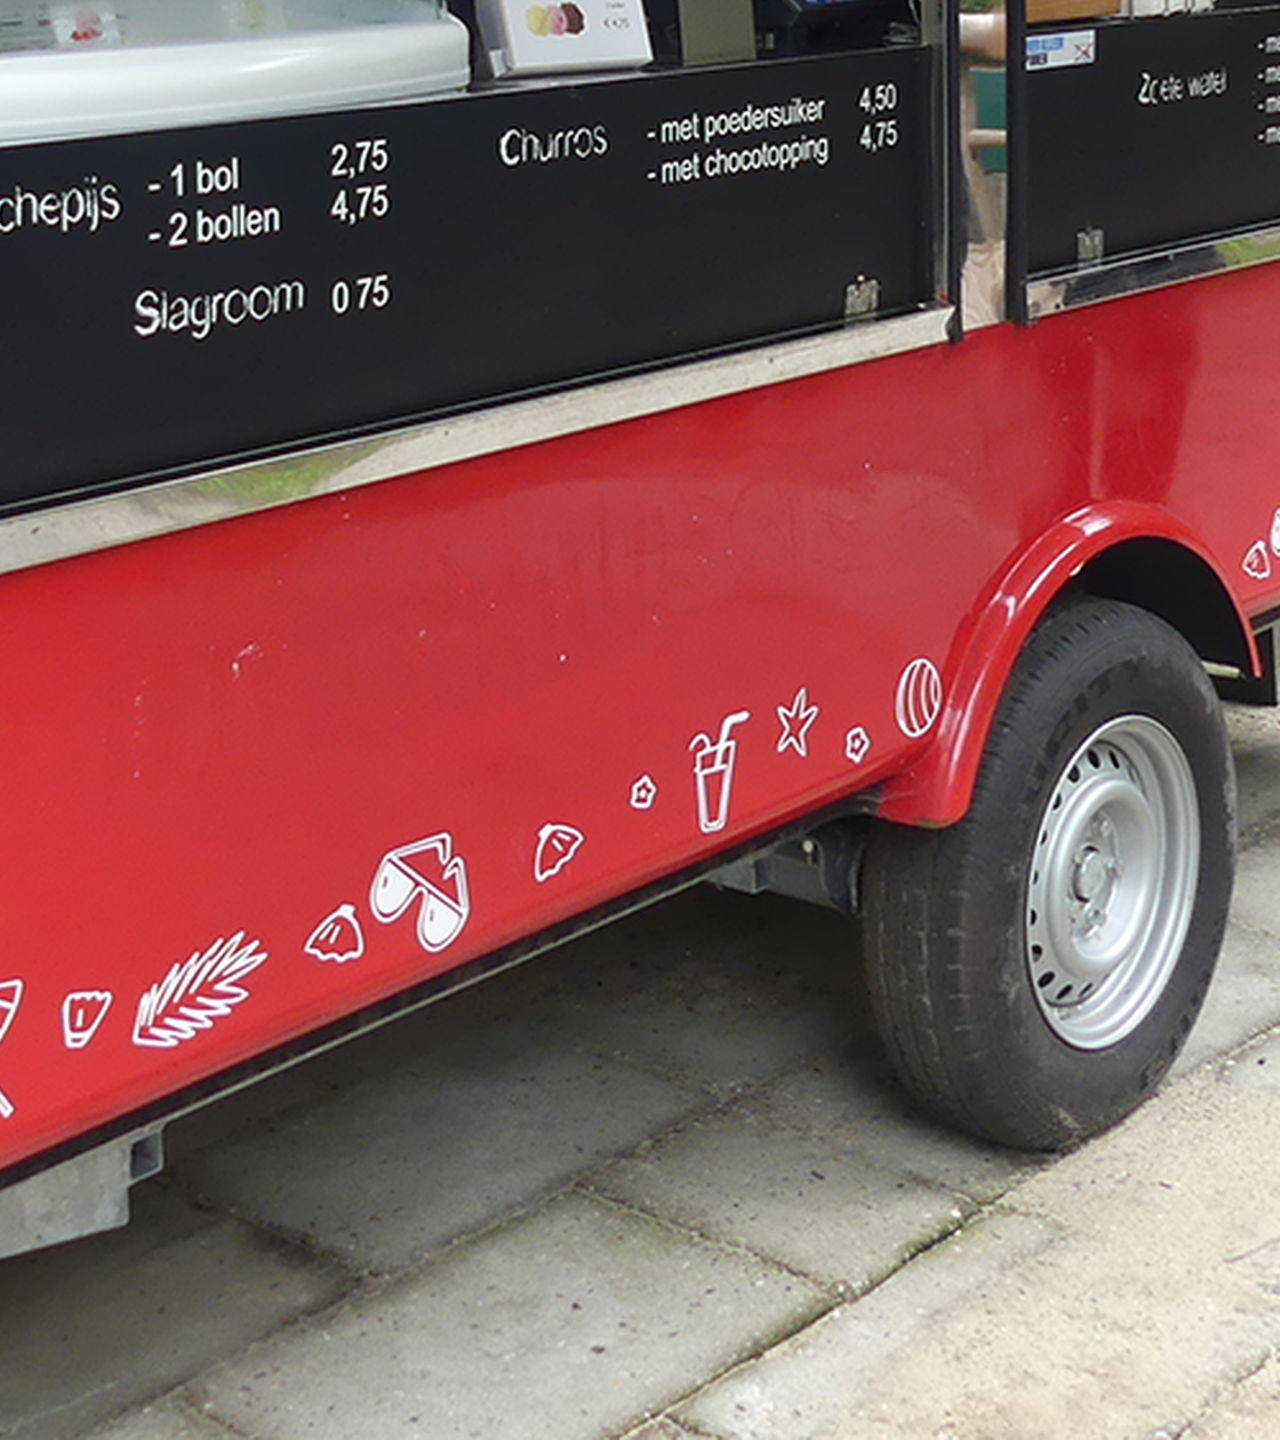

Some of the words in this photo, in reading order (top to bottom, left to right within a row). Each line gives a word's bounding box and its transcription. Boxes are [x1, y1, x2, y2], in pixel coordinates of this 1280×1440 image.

[661, 113, 700, 144] met
[705, 97, 826, 144] poedersuiker
[859, 83, 897, 116] 4,50
[196, 157, 239, 195] bol
[331, 139, 389, 179] 2,75
[500, 125, 608, 166] Churros
[661, 152, 700, 184] met
[705, 134, 829, 171] chocotopping
[860, 120, 899, 153] 4,75
[196, 204, 280, 243] bollen
[330, 184, 389, 225] 4,75
[134, 281, 304, 339] Slagroom
